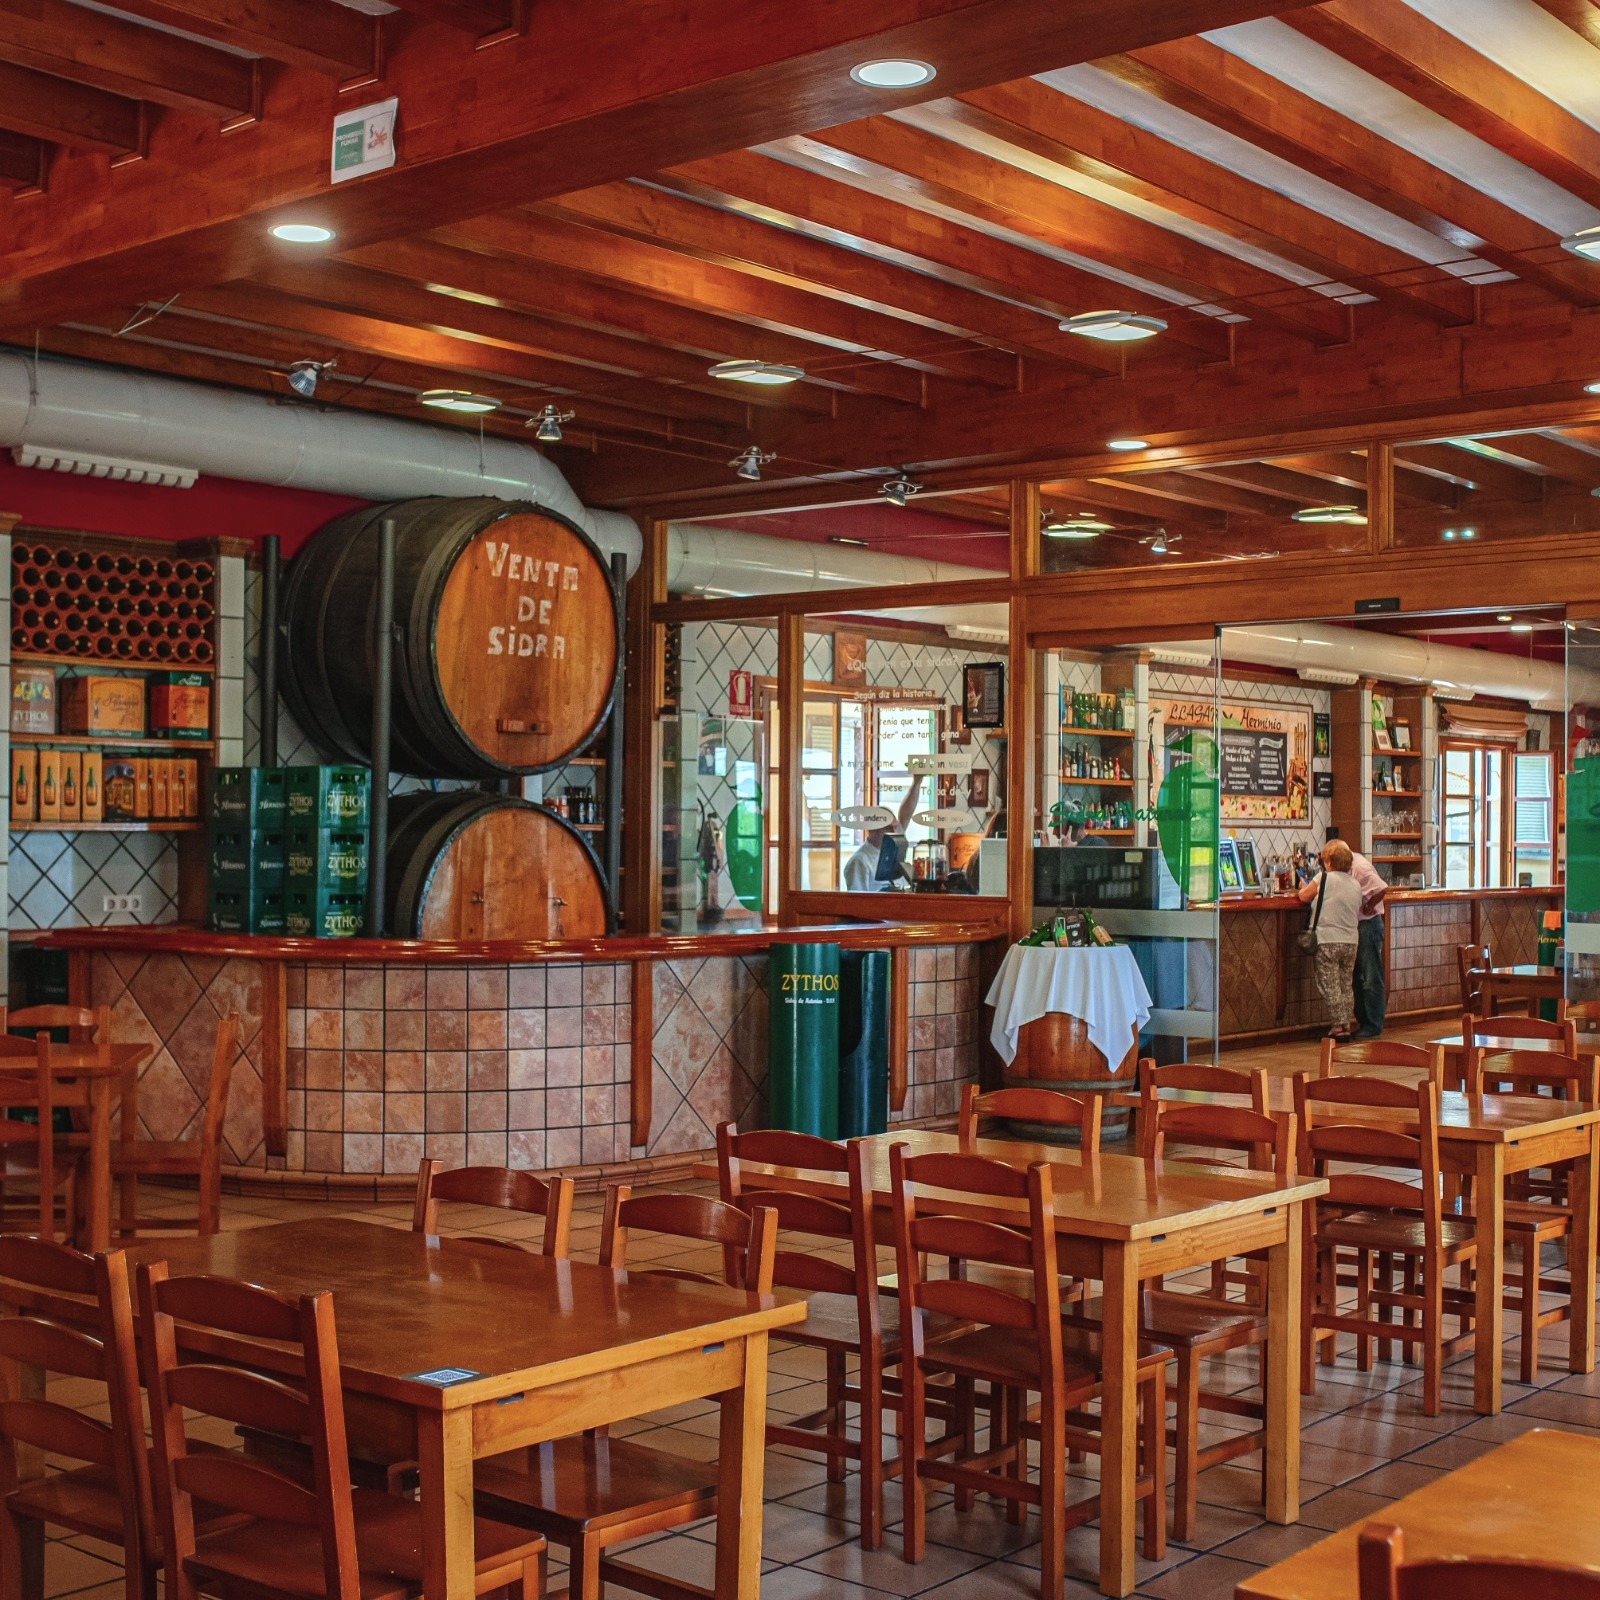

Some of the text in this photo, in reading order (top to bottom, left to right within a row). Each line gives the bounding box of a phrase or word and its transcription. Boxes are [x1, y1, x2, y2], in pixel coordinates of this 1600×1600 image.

[485, 541, 579, 591] VENTA
[518, 595, 552, 625] DE
[853, 690, 876, 702] Según
[879, 690, 890, 699] diz
[893, 690, 901, 698] la
[900, 718, 913, 727] que
[901, 731, 915, 739] con
[327, 794, 366, 808] ZYTHOS
[328, 855, 367, 869] ZYTHOS
[324, 915, 364, 929] ZYTHOS
[781, 974, 840, 991] ZYTHOS
